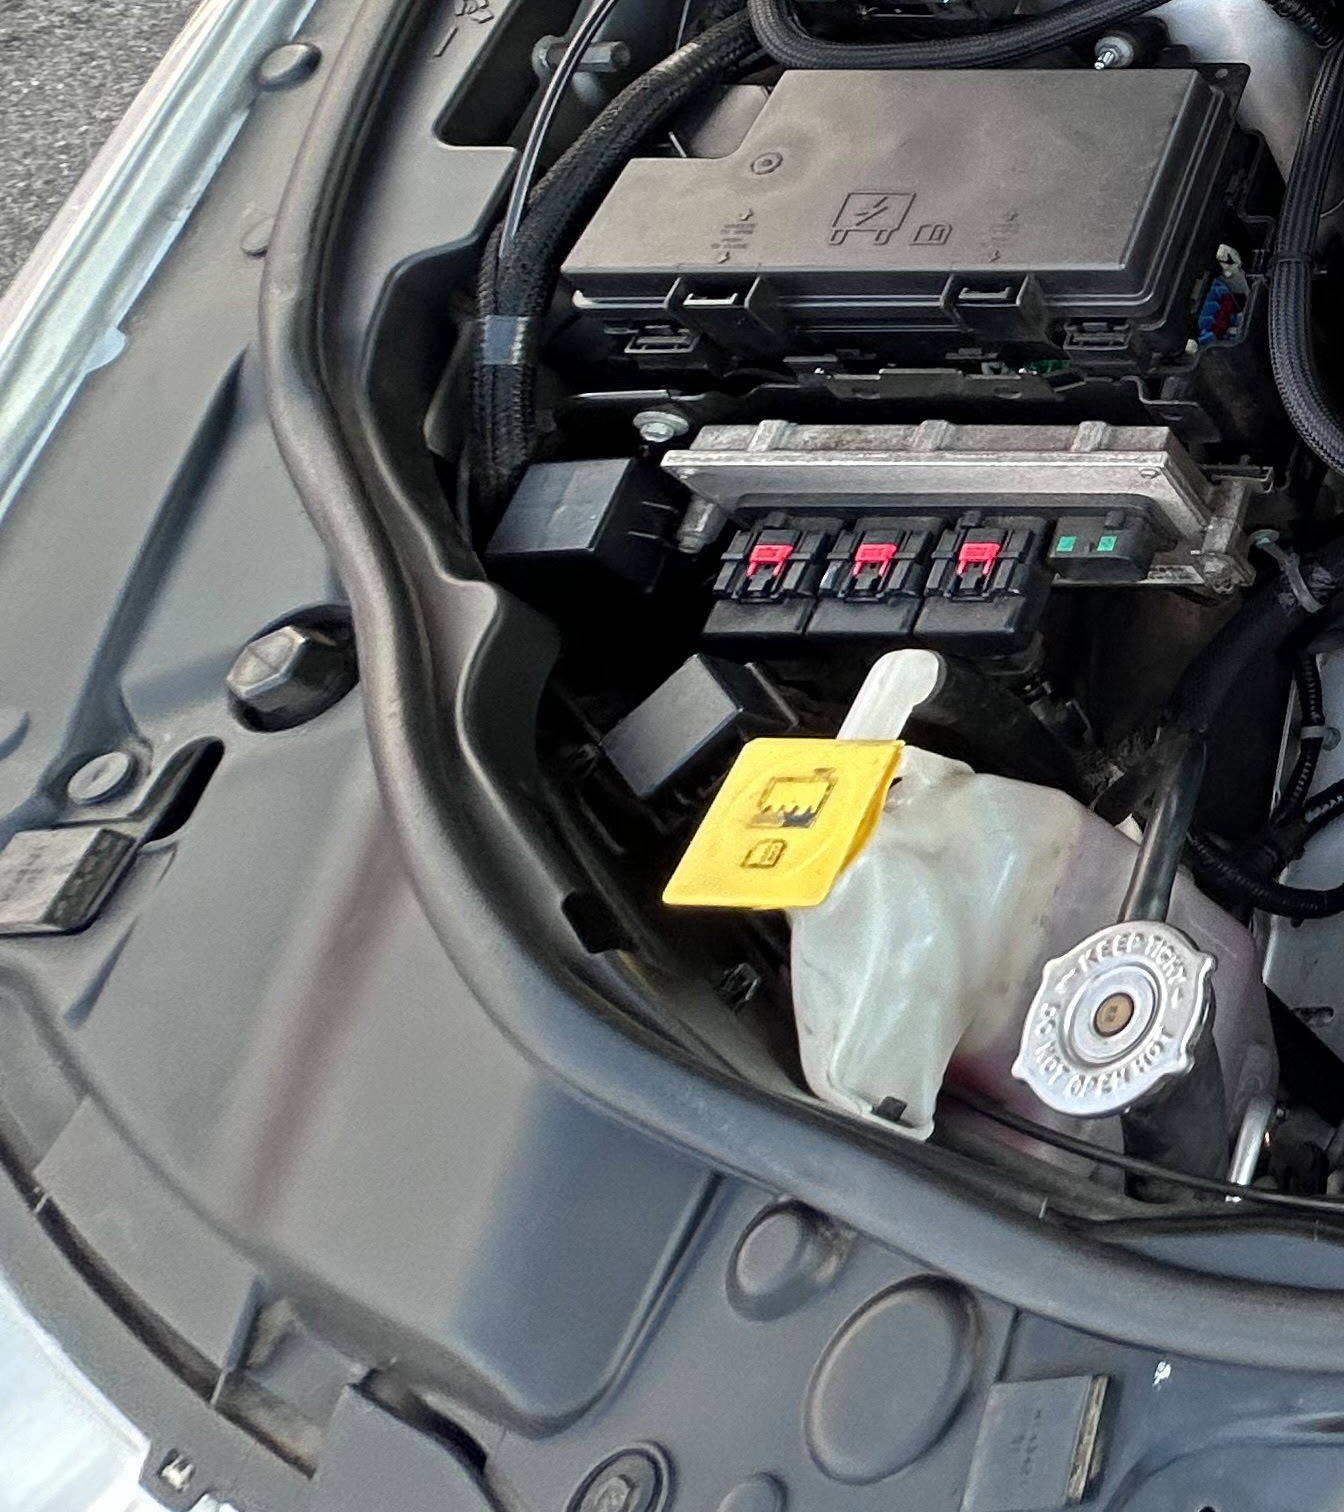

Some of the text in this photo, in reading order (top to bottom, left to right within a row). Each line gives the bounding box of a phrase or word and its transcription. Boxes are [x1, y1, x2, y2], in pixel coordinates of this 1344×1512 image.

[1078, 931, 1187, 985] KEEP TIGHT
[1035, 1041, 1070, 1086] NOT
[1065, 1068, 1131, 1098] OPEN
[1132, 1025, 1175, 1073] HOT
